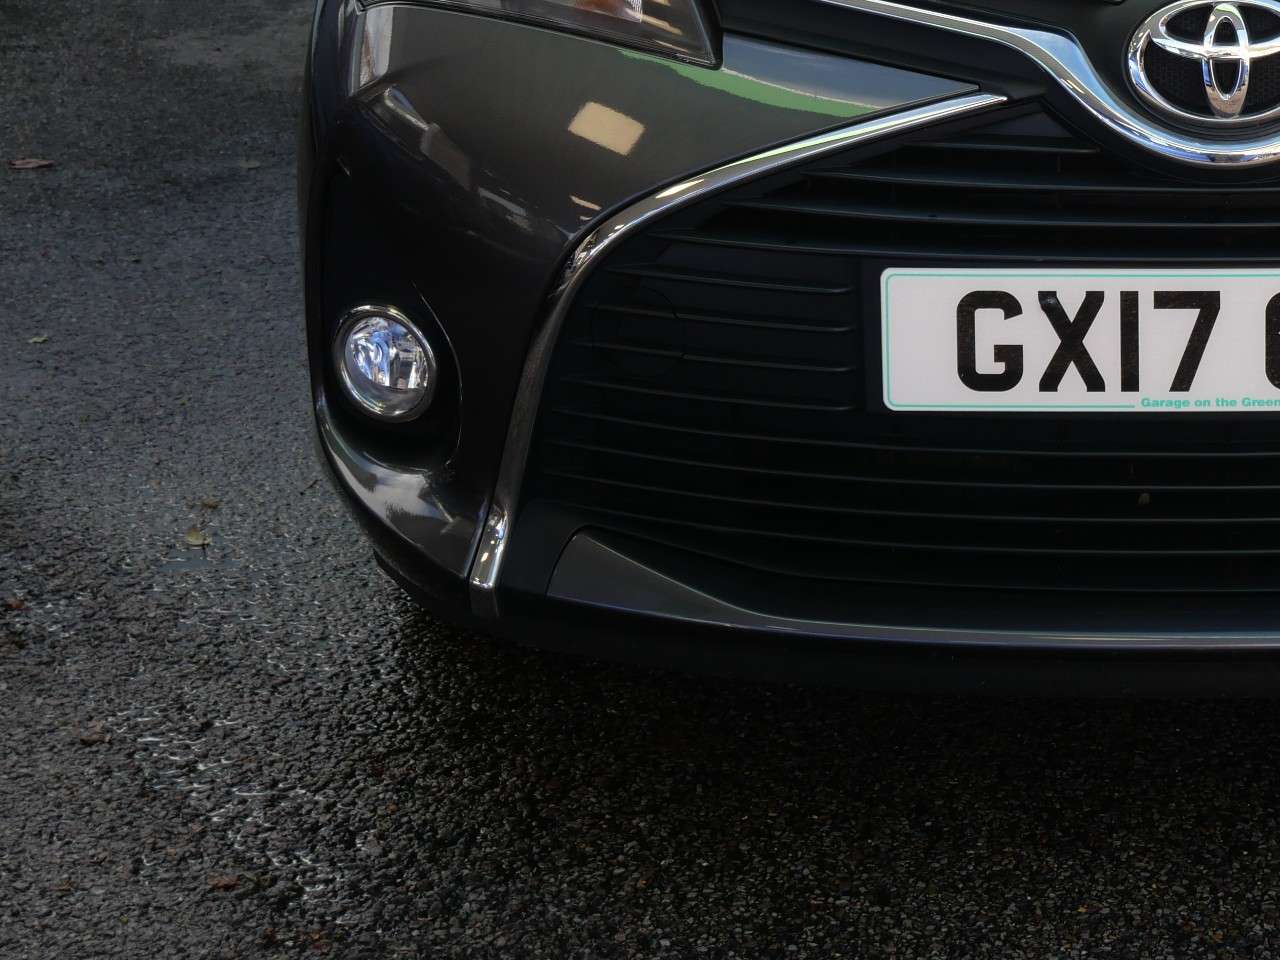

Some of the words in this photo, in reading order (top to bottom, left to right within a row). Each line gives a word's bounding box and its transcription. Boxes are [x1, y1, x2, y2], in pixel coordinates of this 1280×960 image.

[956, 290, 1221, 392] GX17
[1140, 397, 1190, 409] Garage
[1194, 399, 1211, 408] on
[1215, 397, 1235, 407] the
